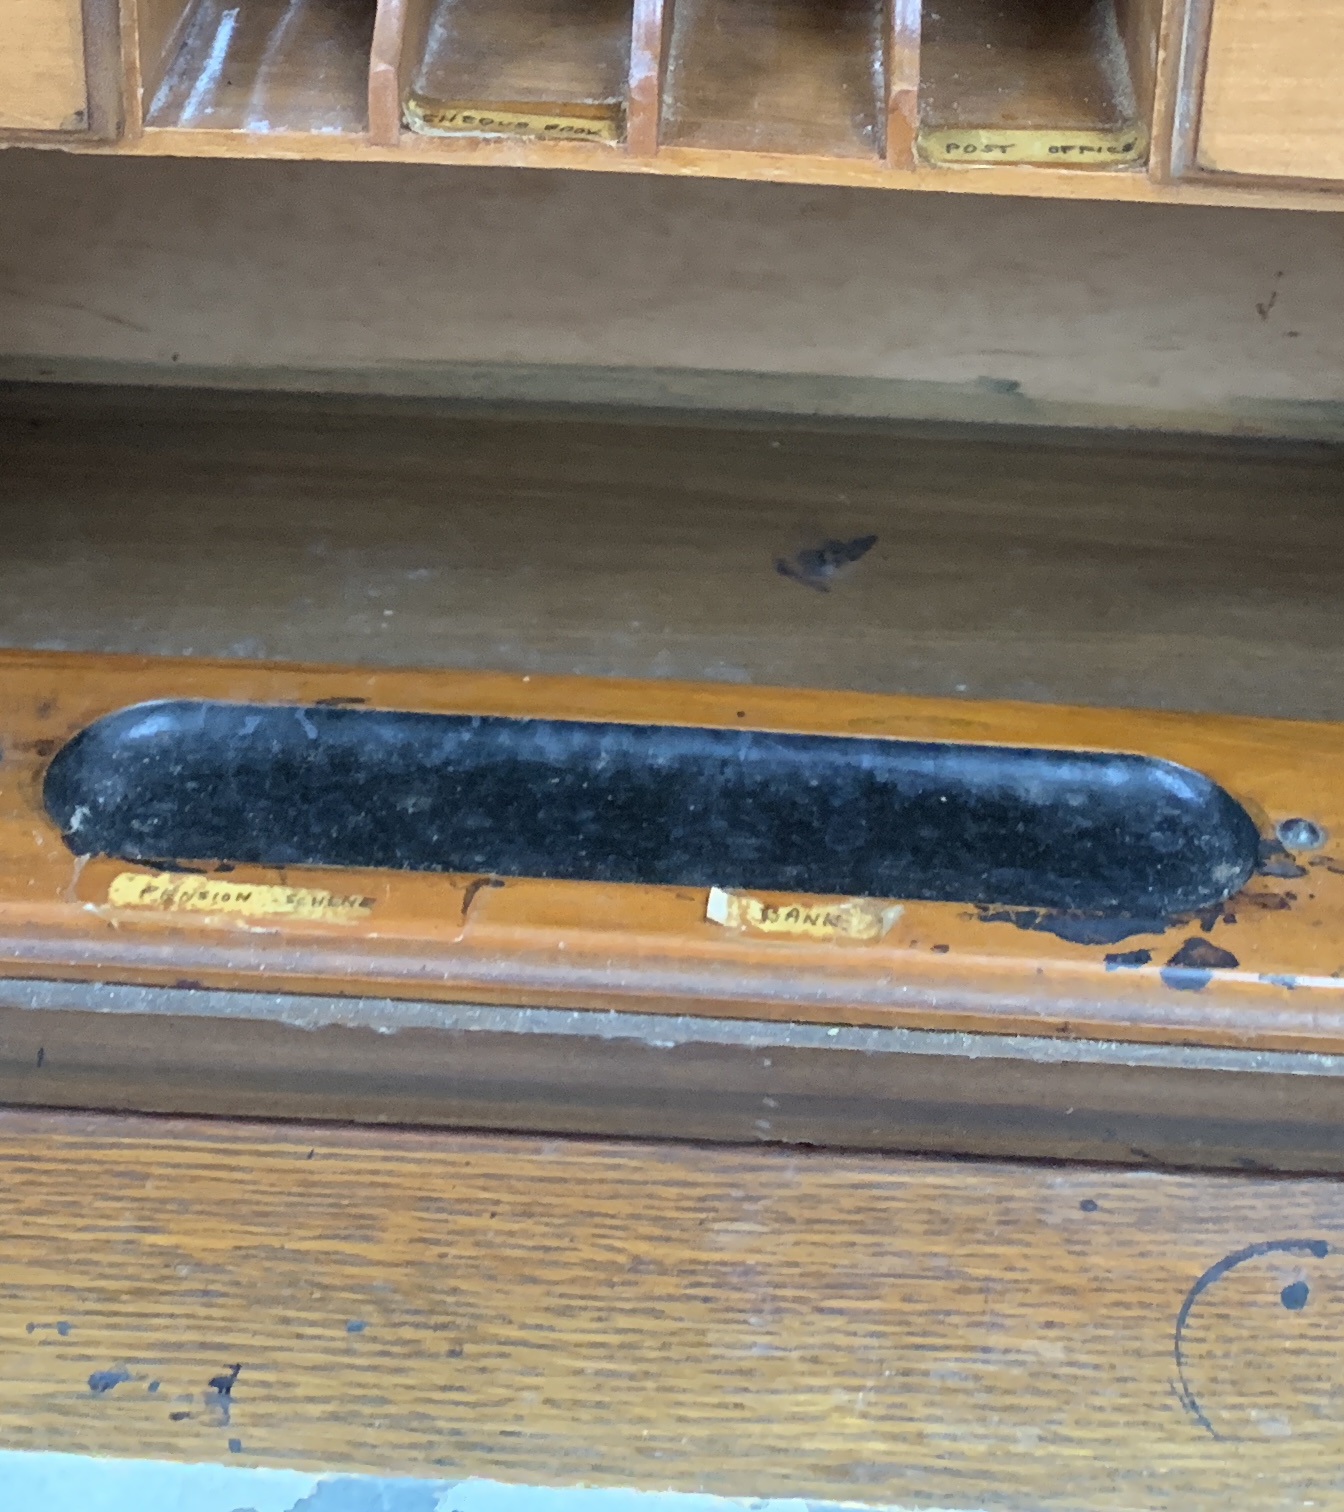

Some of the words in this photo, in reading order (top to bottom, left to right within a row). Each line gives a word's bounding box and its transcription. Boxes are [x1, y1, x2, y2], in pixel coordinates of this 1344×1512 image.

[945, 142, 1016, 155] POST
[1047, 137, 1138, 155] OFFICE
[138, 884, 253, 904] PENSION
